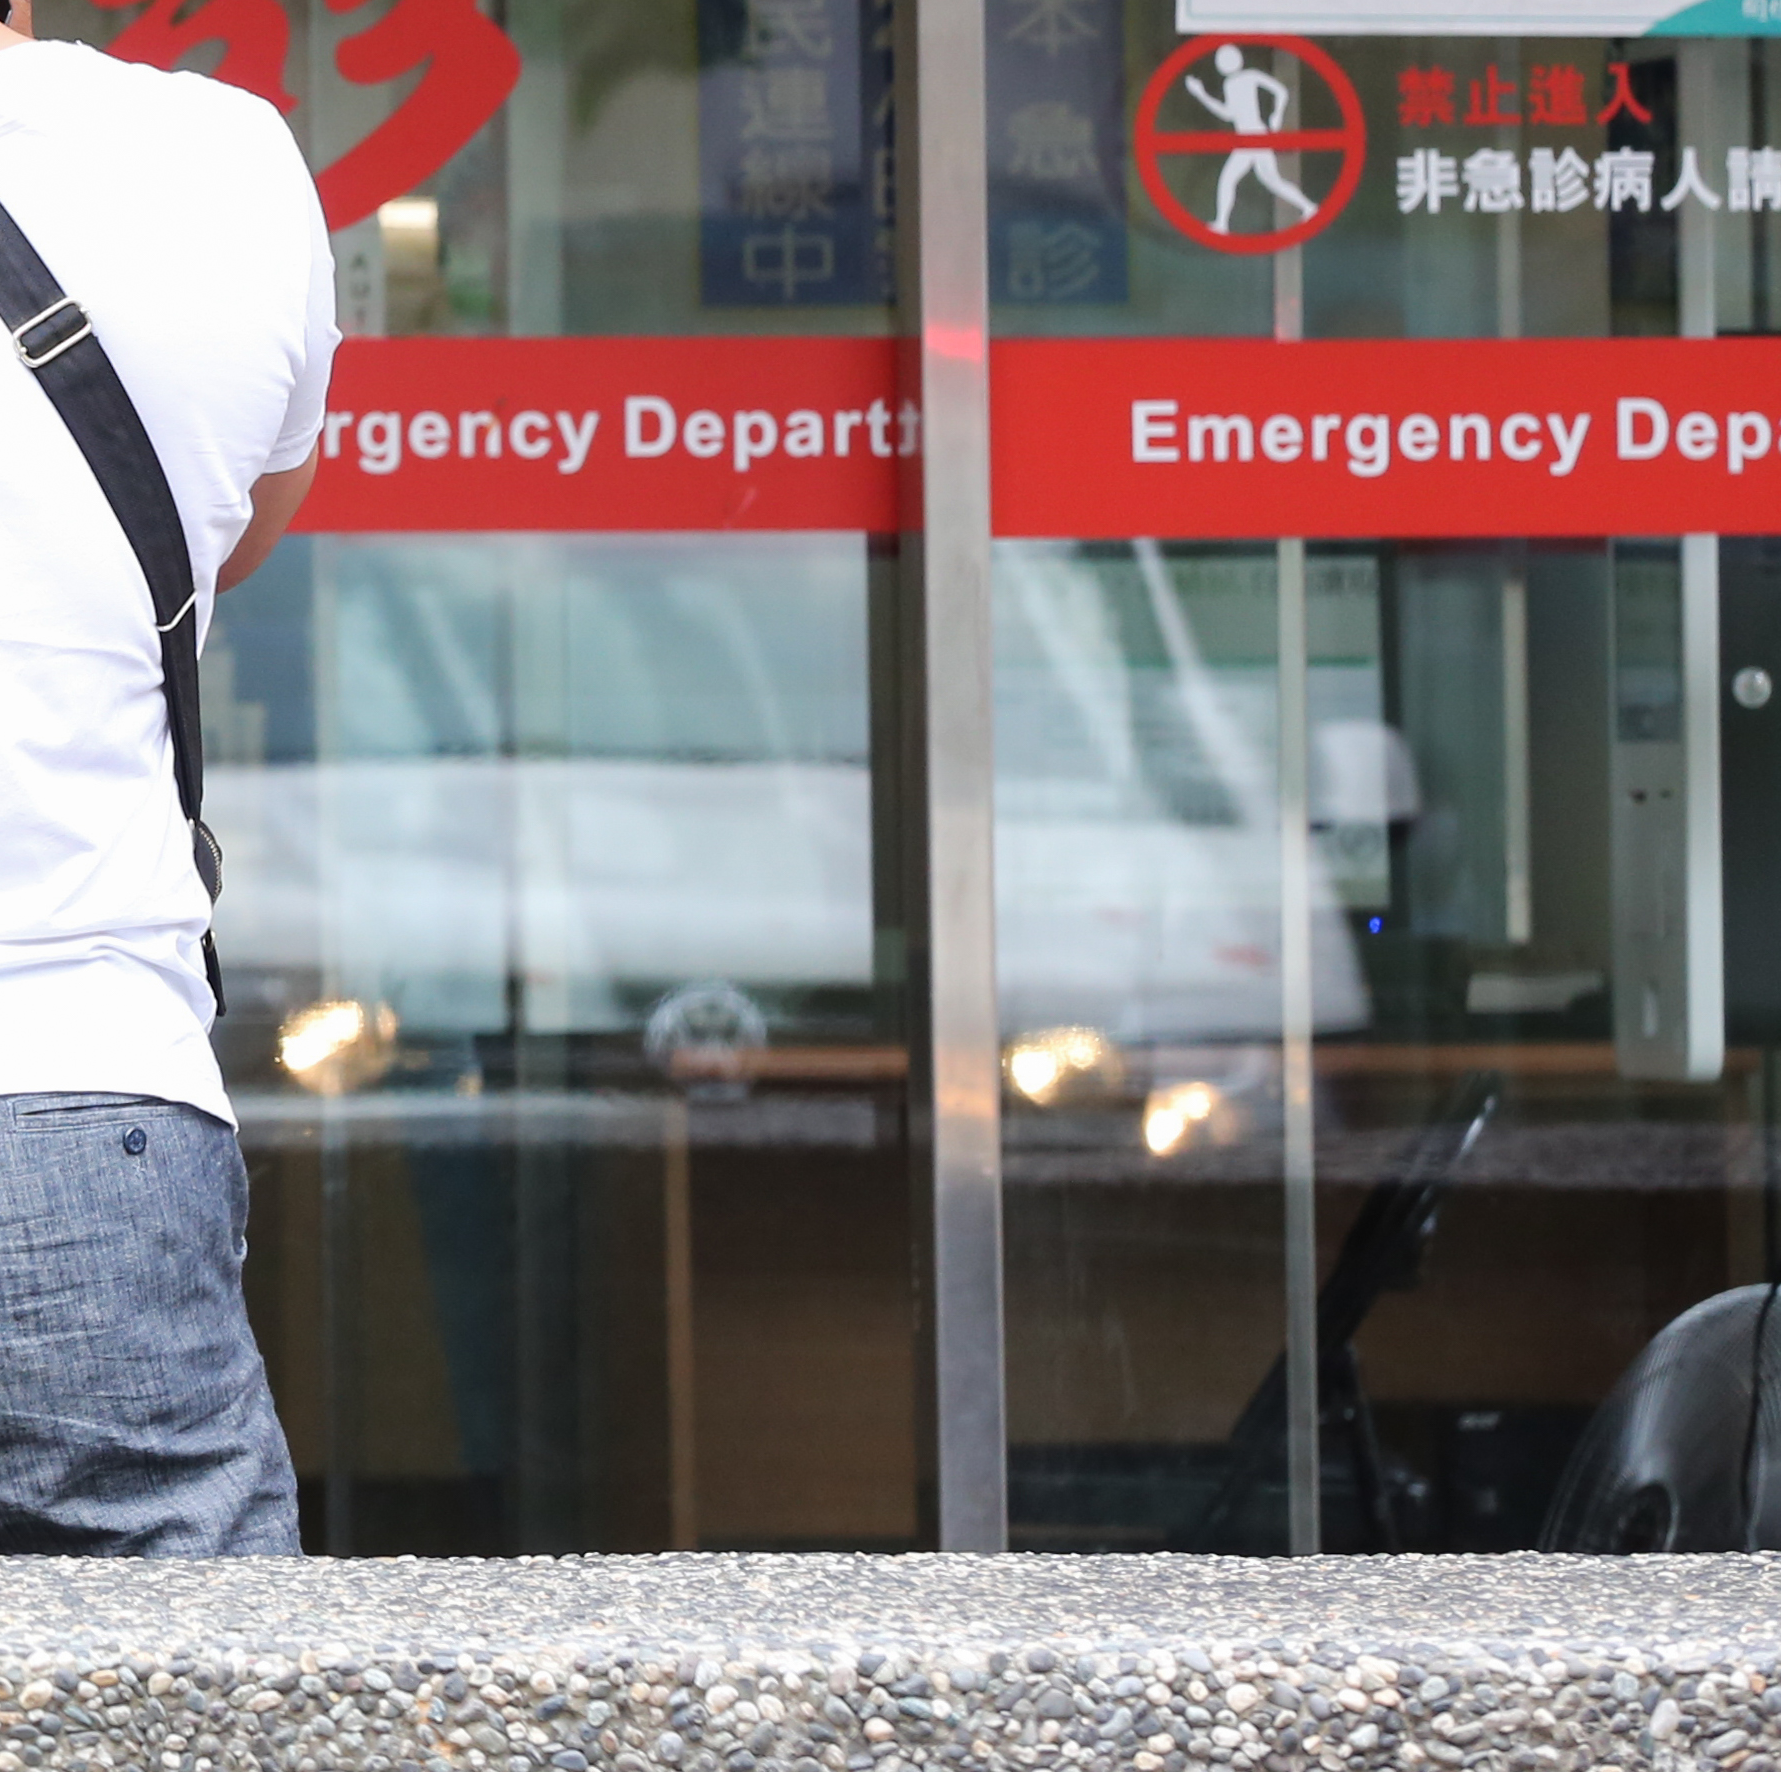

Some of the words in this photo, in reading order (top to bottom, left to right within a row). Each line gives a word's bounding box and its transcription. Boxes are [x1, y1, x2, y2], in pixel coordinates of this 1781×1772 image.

[1397, 63, 1654, 127] 禁止進入
[1396, 146, 1781, 214] 非急診病人請
[1130, 398, 1591, 478] Emergency
[1615, 395, 1781, 476] Dep
